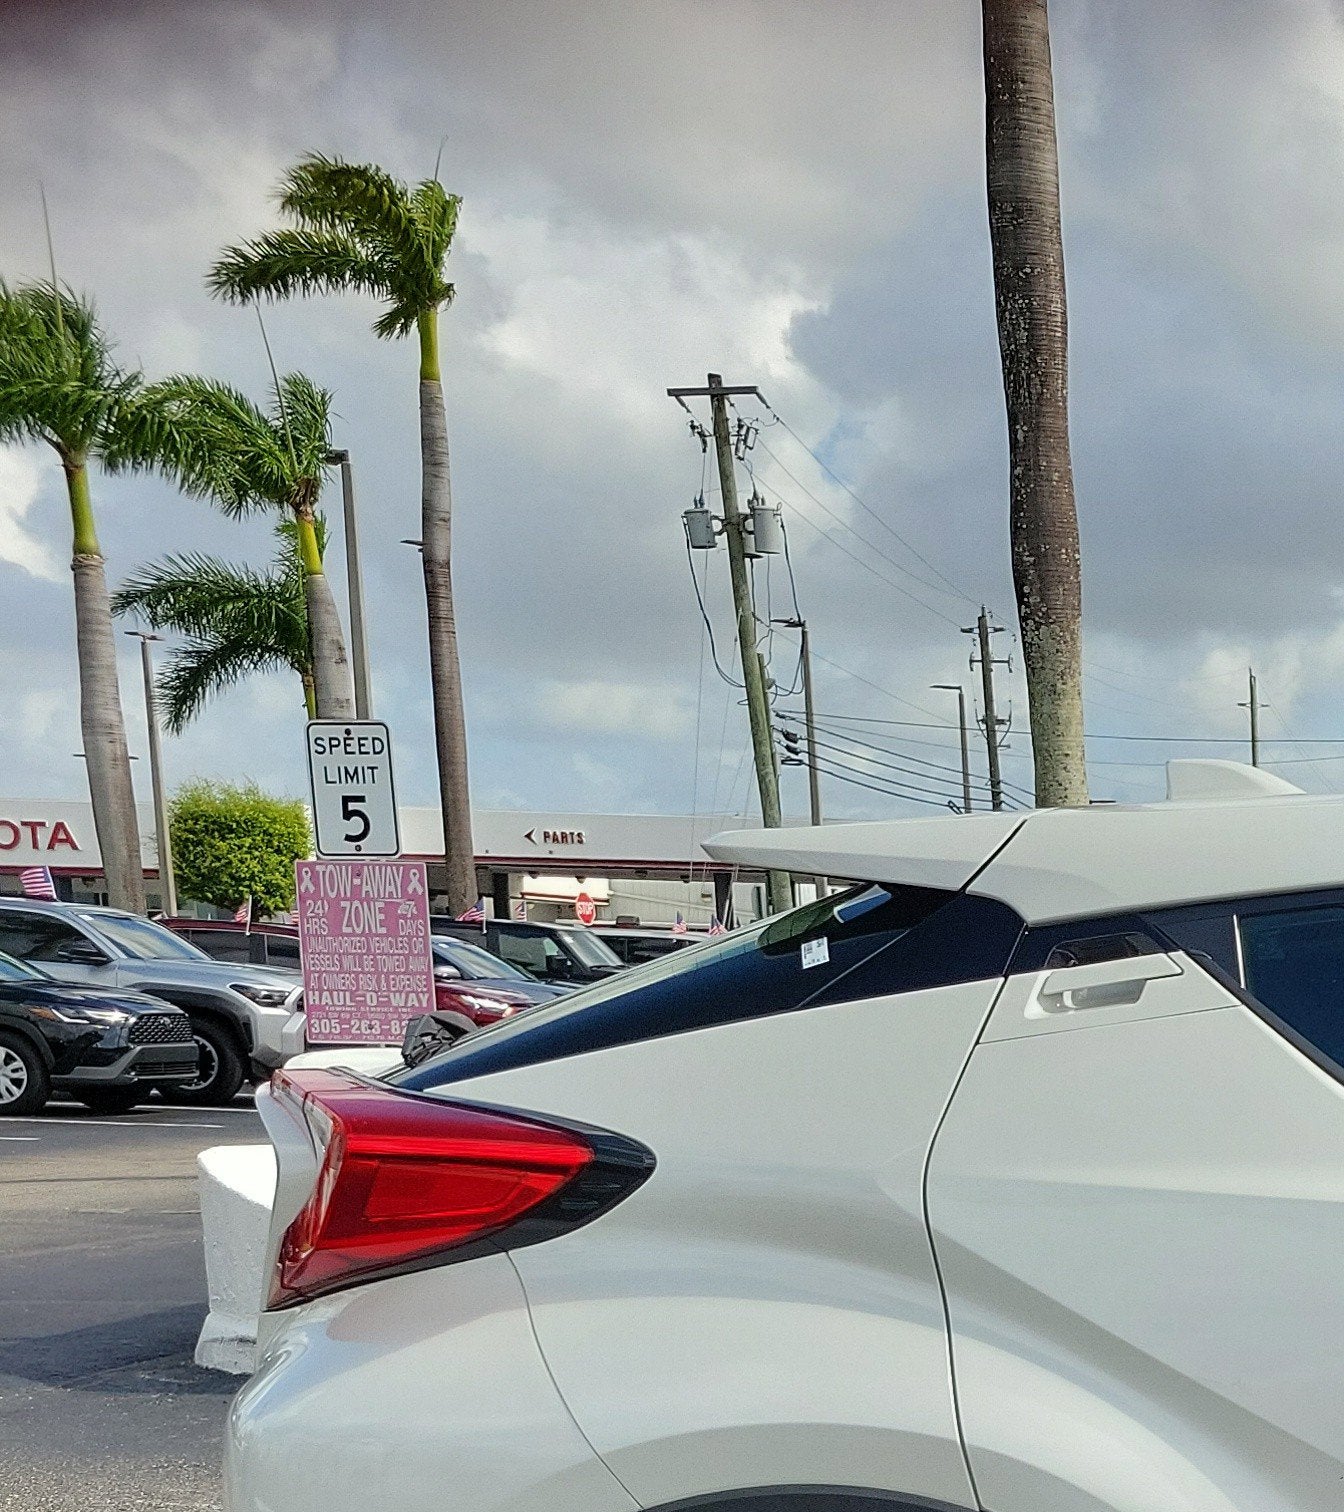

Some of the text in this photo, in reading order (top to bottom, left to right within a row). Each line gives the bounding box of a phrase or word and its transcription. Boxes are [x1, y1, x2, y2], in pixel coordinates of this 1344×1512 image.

[314, 736, 385, 755] SPEED
[323, 765, 379, 784] LIMIT
[341, 795, 371, 842] 5
[0, 819, 80, 851] OTA
[543, 830, 585, 845] PARTS
[316, 864, 404, 899] TOW-AWAY
[304, 918, 329, 935] HRS
[340, 900, 387, 934] ZONE
[399, 920, 425, 937] DAYS
[306, 937, 425, 955] UNAUTHORIZED VEHICLES OR
[304, 954, 340, 972] VESSELS
[342, 955, 362, 972] WILL
[364, 955, 375, 972] BE
[376, 956, 406, 973] TOWED
[310, 973, 320, 989] AT
[359, 975, 378, 991] RISK
[390, 975, 427, 992] EXPENSE
[308, 990, 429, 1008] HAUL-O-WAY
[310, 1019, 409, 1035] 305-263-82
